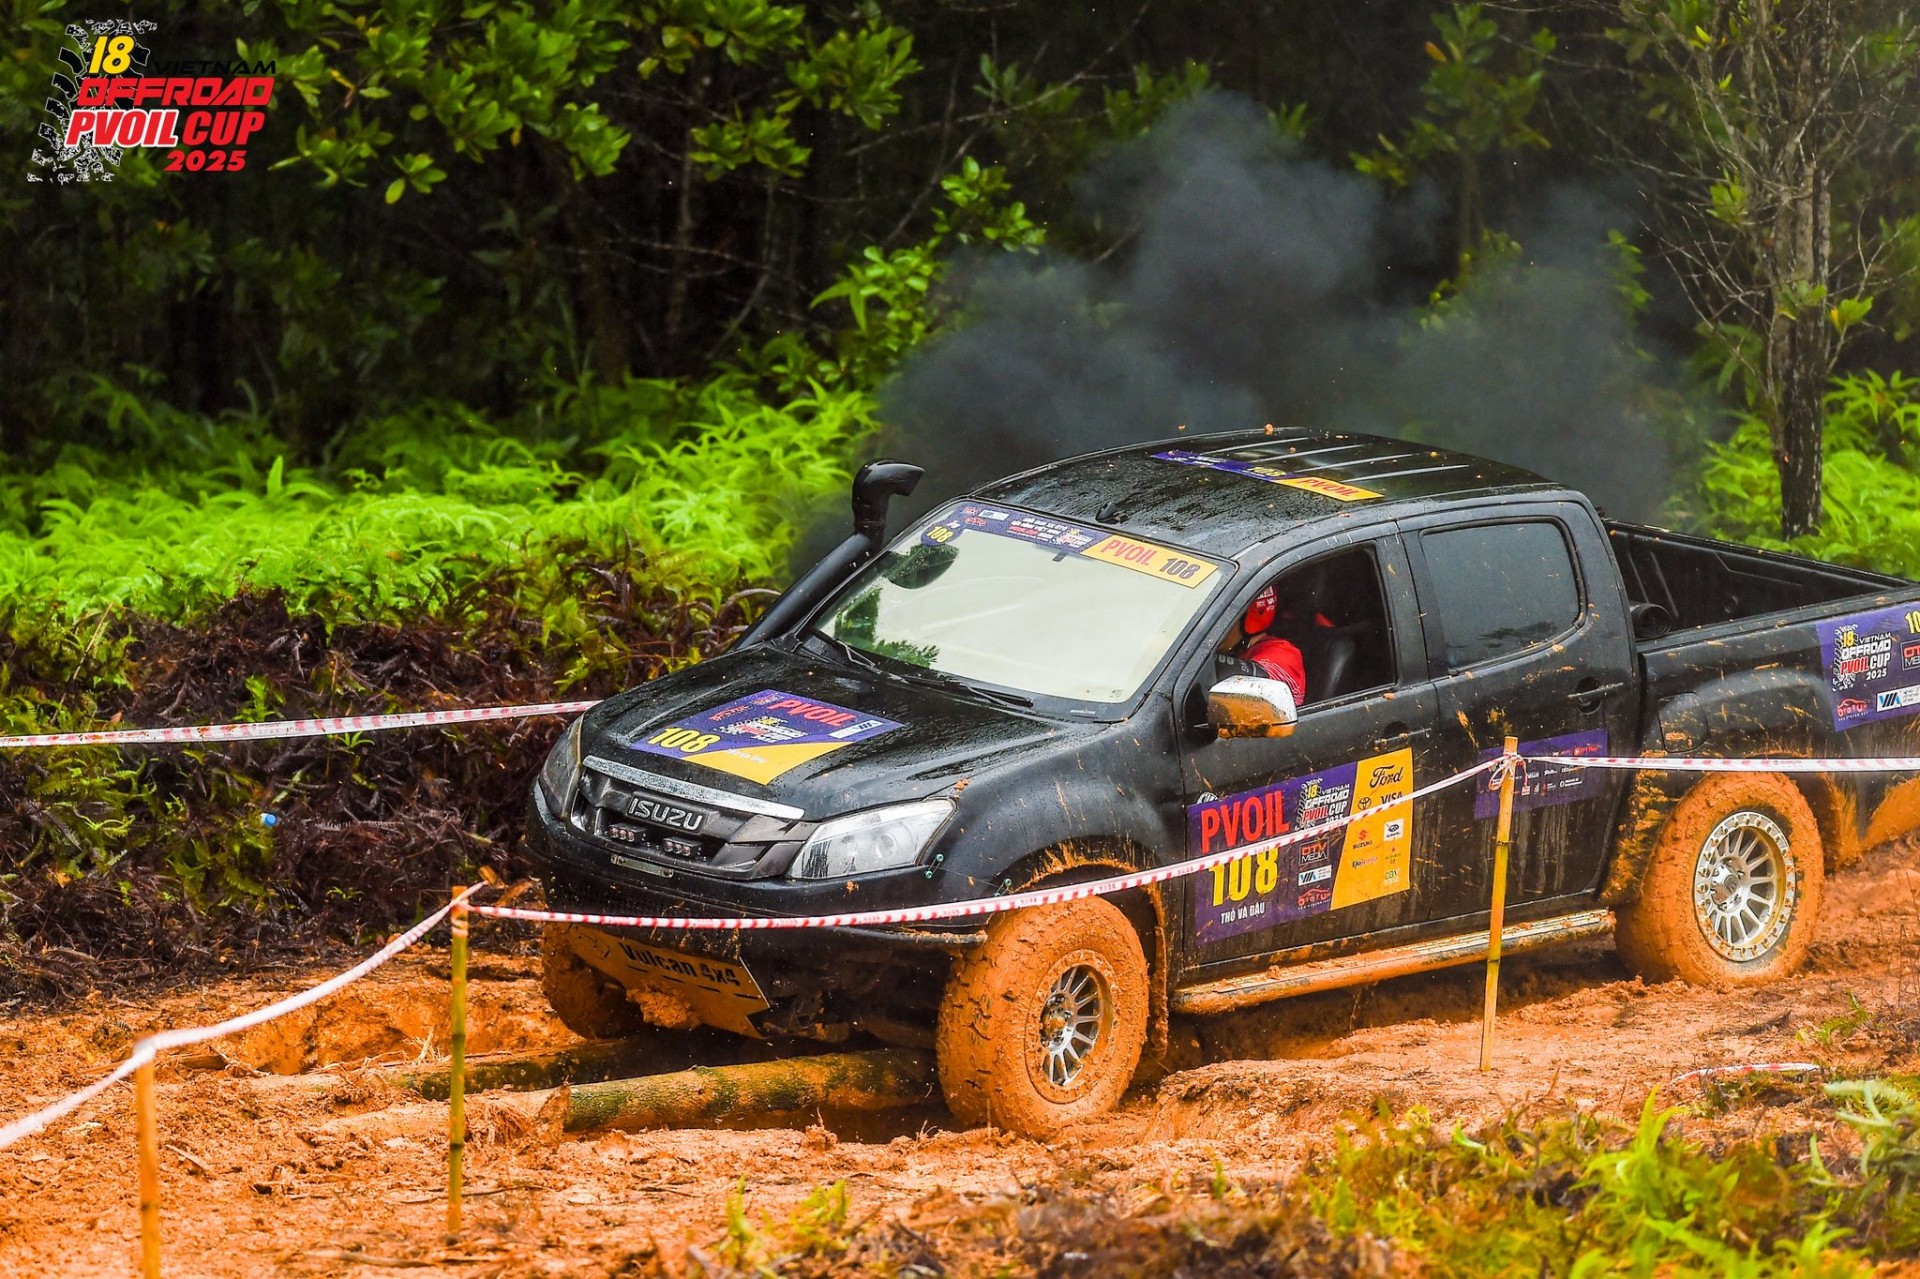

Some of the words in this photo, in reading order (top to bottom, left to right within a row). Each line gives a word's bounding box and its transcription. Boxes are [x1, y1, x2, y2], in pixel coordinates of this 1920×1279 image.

[1299, 478, 1359, 498] PVOIL
[926, 526, 954, 543] 108
[1100, 538, 1159, 566] PVOIL
[1161, 556, 1202, 580] 108
[1904, 611, 1920, 635] 10
[1841, 639, 1892, 660] OFFROAD
[1842, 630, 1855, 648] 18
[1860, 632, 1891, 645] VIETNAM
[1840, 656, 1869, 676] PVOIL
[1869, 652, 1891, 670] CUP
[1866, 669, 1888, 681] 2025
[767, 699, 858, 728] PVOIL
[647, 727, 722, 753] 108
[1369, 764, 1404, 788] Ford
[1304, 789, 1350, 810] OFFROAD
[1307, 784, 1318, 799] 18
[1321, 783, 1350, 795] VIETNAM
[627, 797, 703, 832] ISUZU
[1200, 790, 1290, 854] PVOIL
[1301, 805, 1328, 825] PVOIL
[1328, 801, 1348, 816] CUP
[1352, 840, 1373, 849] SUZUKI
[1208, 847, 1279, 907] 108
[618, 942, 699, 978] Vulcan
[700, 963, 742, 988] 4x4
